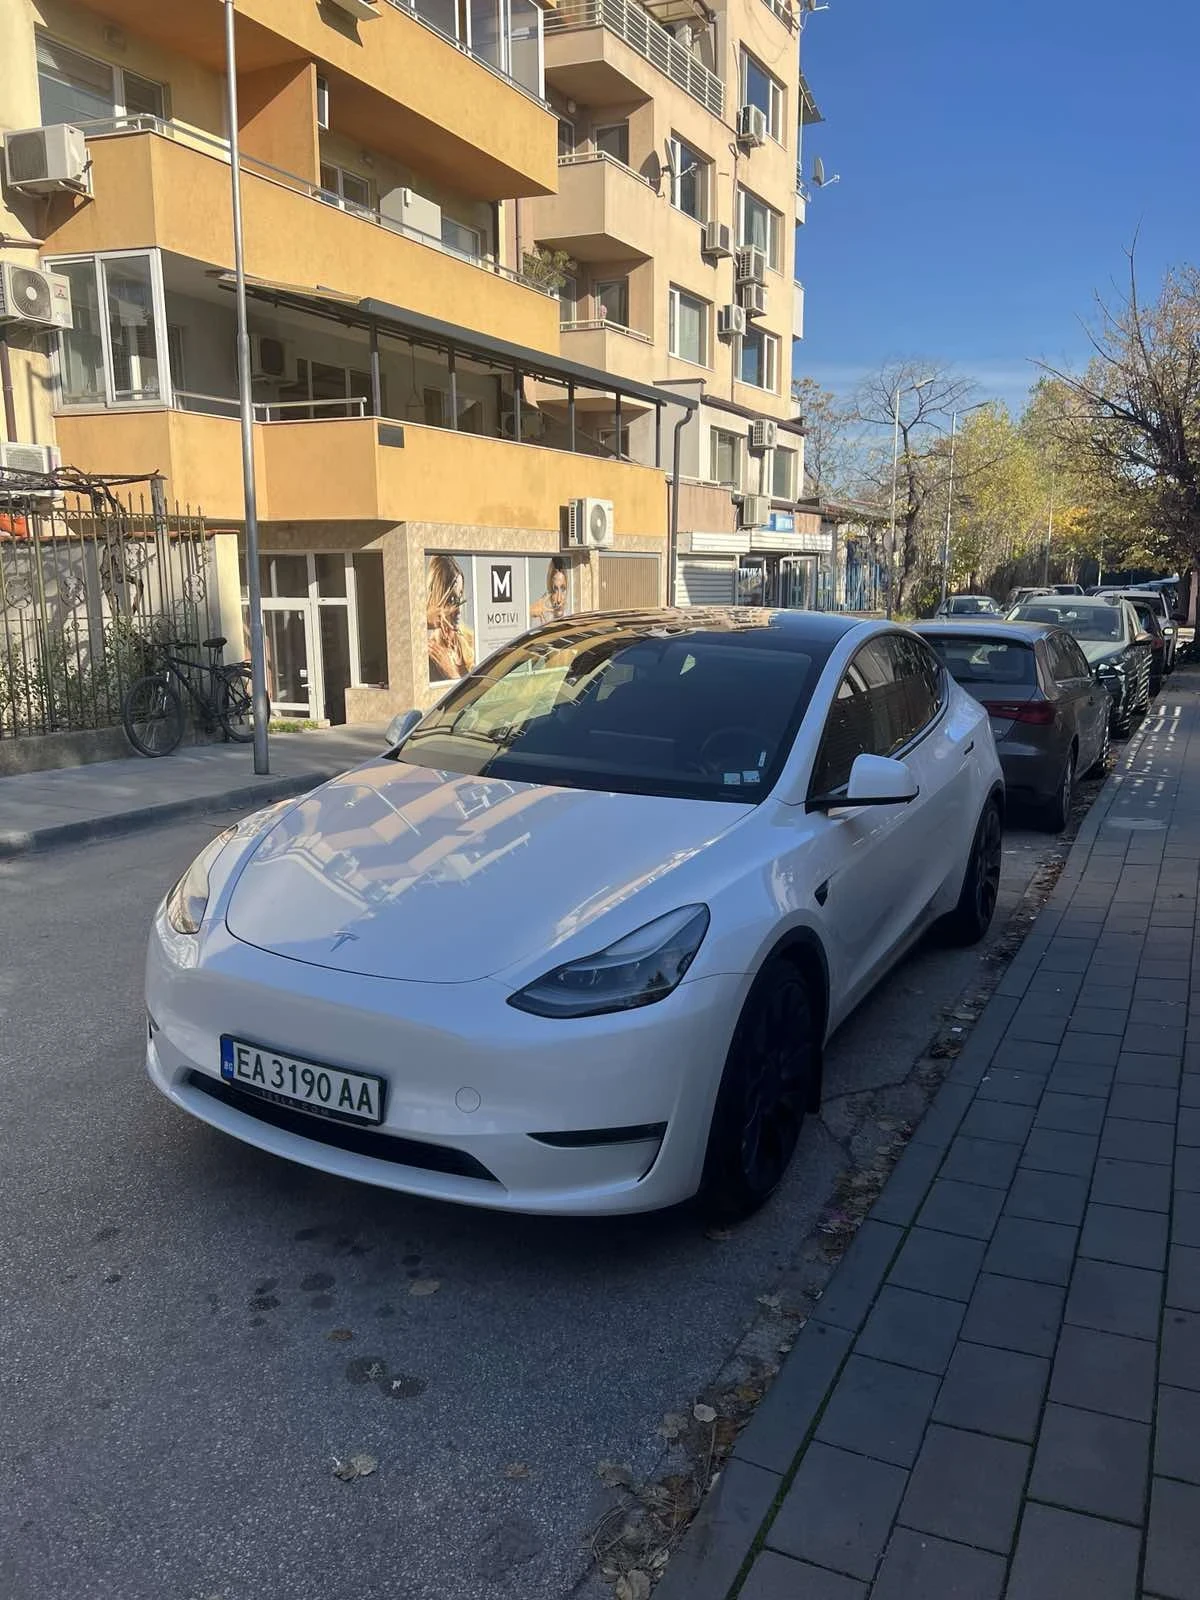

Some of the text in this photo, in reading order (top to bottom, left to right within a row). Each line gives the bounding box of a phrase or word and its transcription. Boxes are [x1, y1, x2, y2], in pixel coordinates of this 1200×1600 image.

[492, 570, 511, 598] M
[487, 612, 519, 625] MOTIVI
[236, 1047, 266, 1085] EA
[270, 1059, 332, 1102] 3190
[338, 1078, 373, 1114] AA
